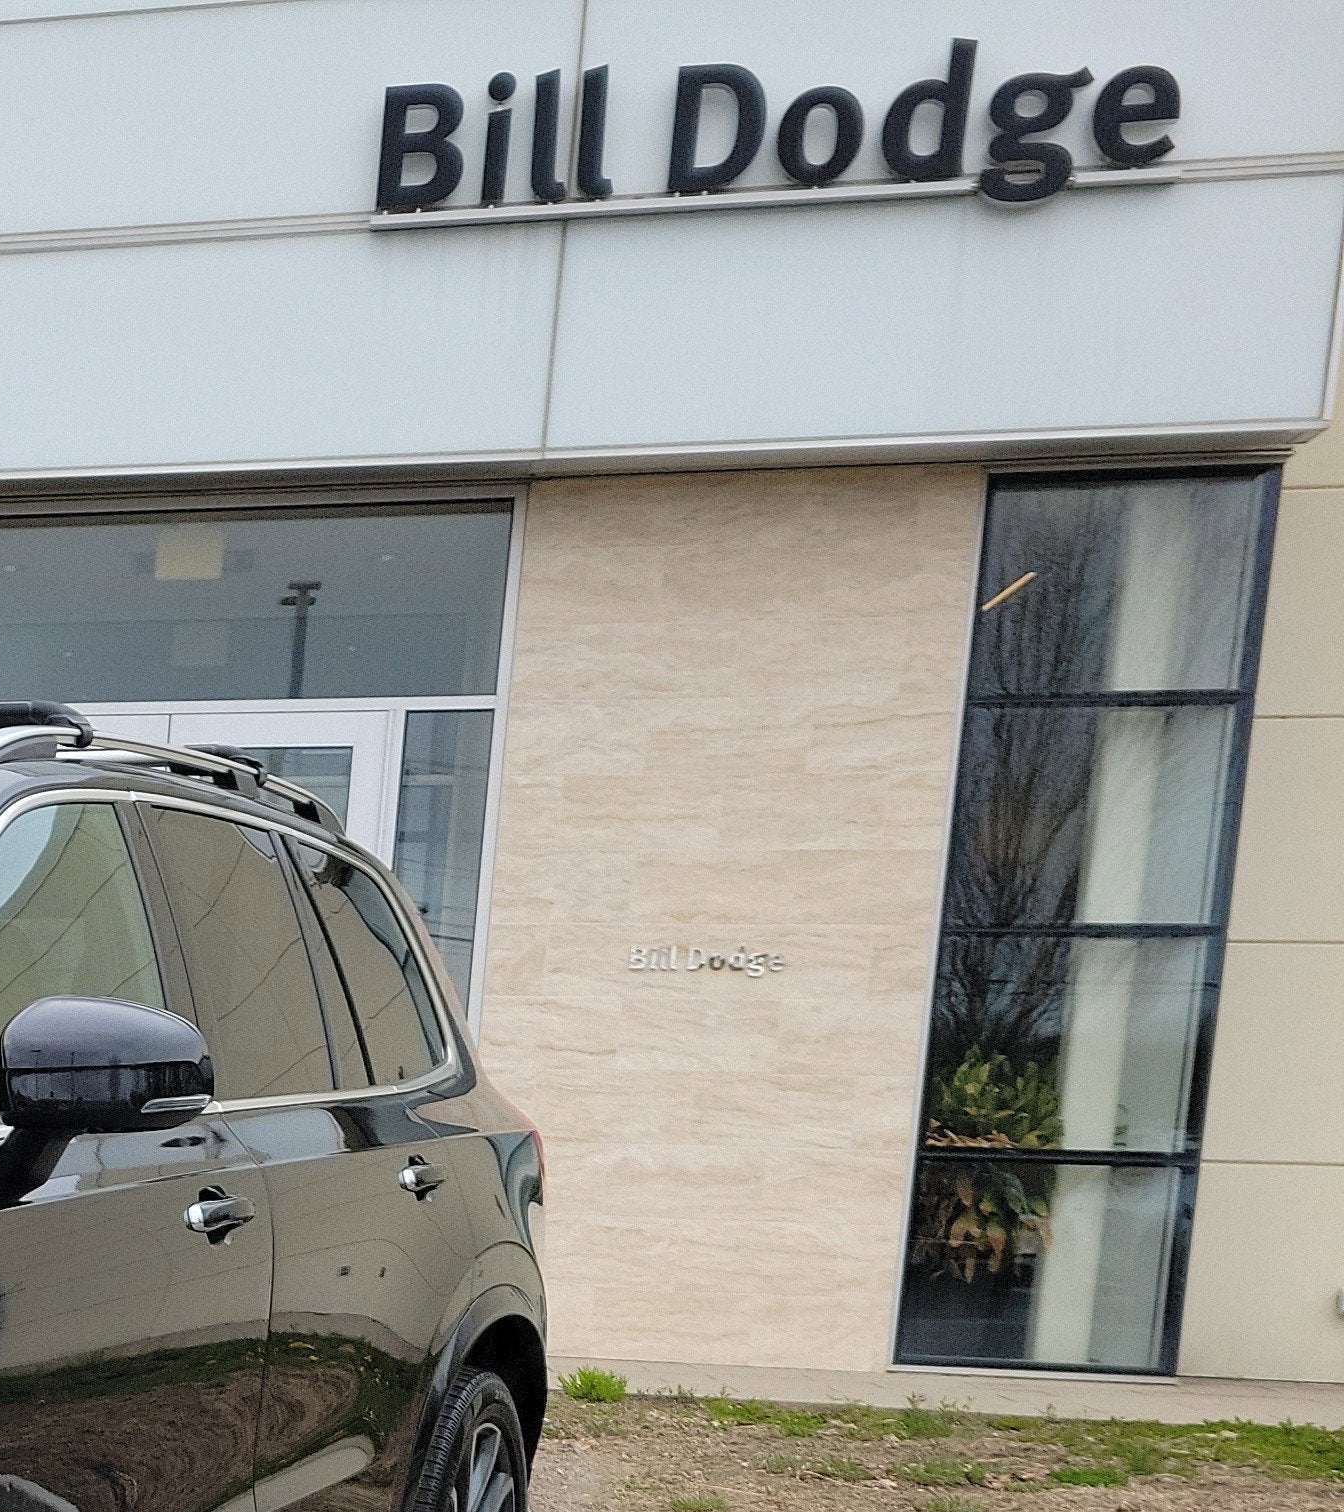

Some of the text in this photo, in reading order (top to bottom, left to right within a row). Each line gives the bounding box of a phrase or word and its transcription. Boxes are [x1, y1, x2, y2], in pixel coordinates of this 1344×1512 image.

[376, 37, 1182, 213] Bill Dodge
[628, 945, 786, 978] Bill Dodge
